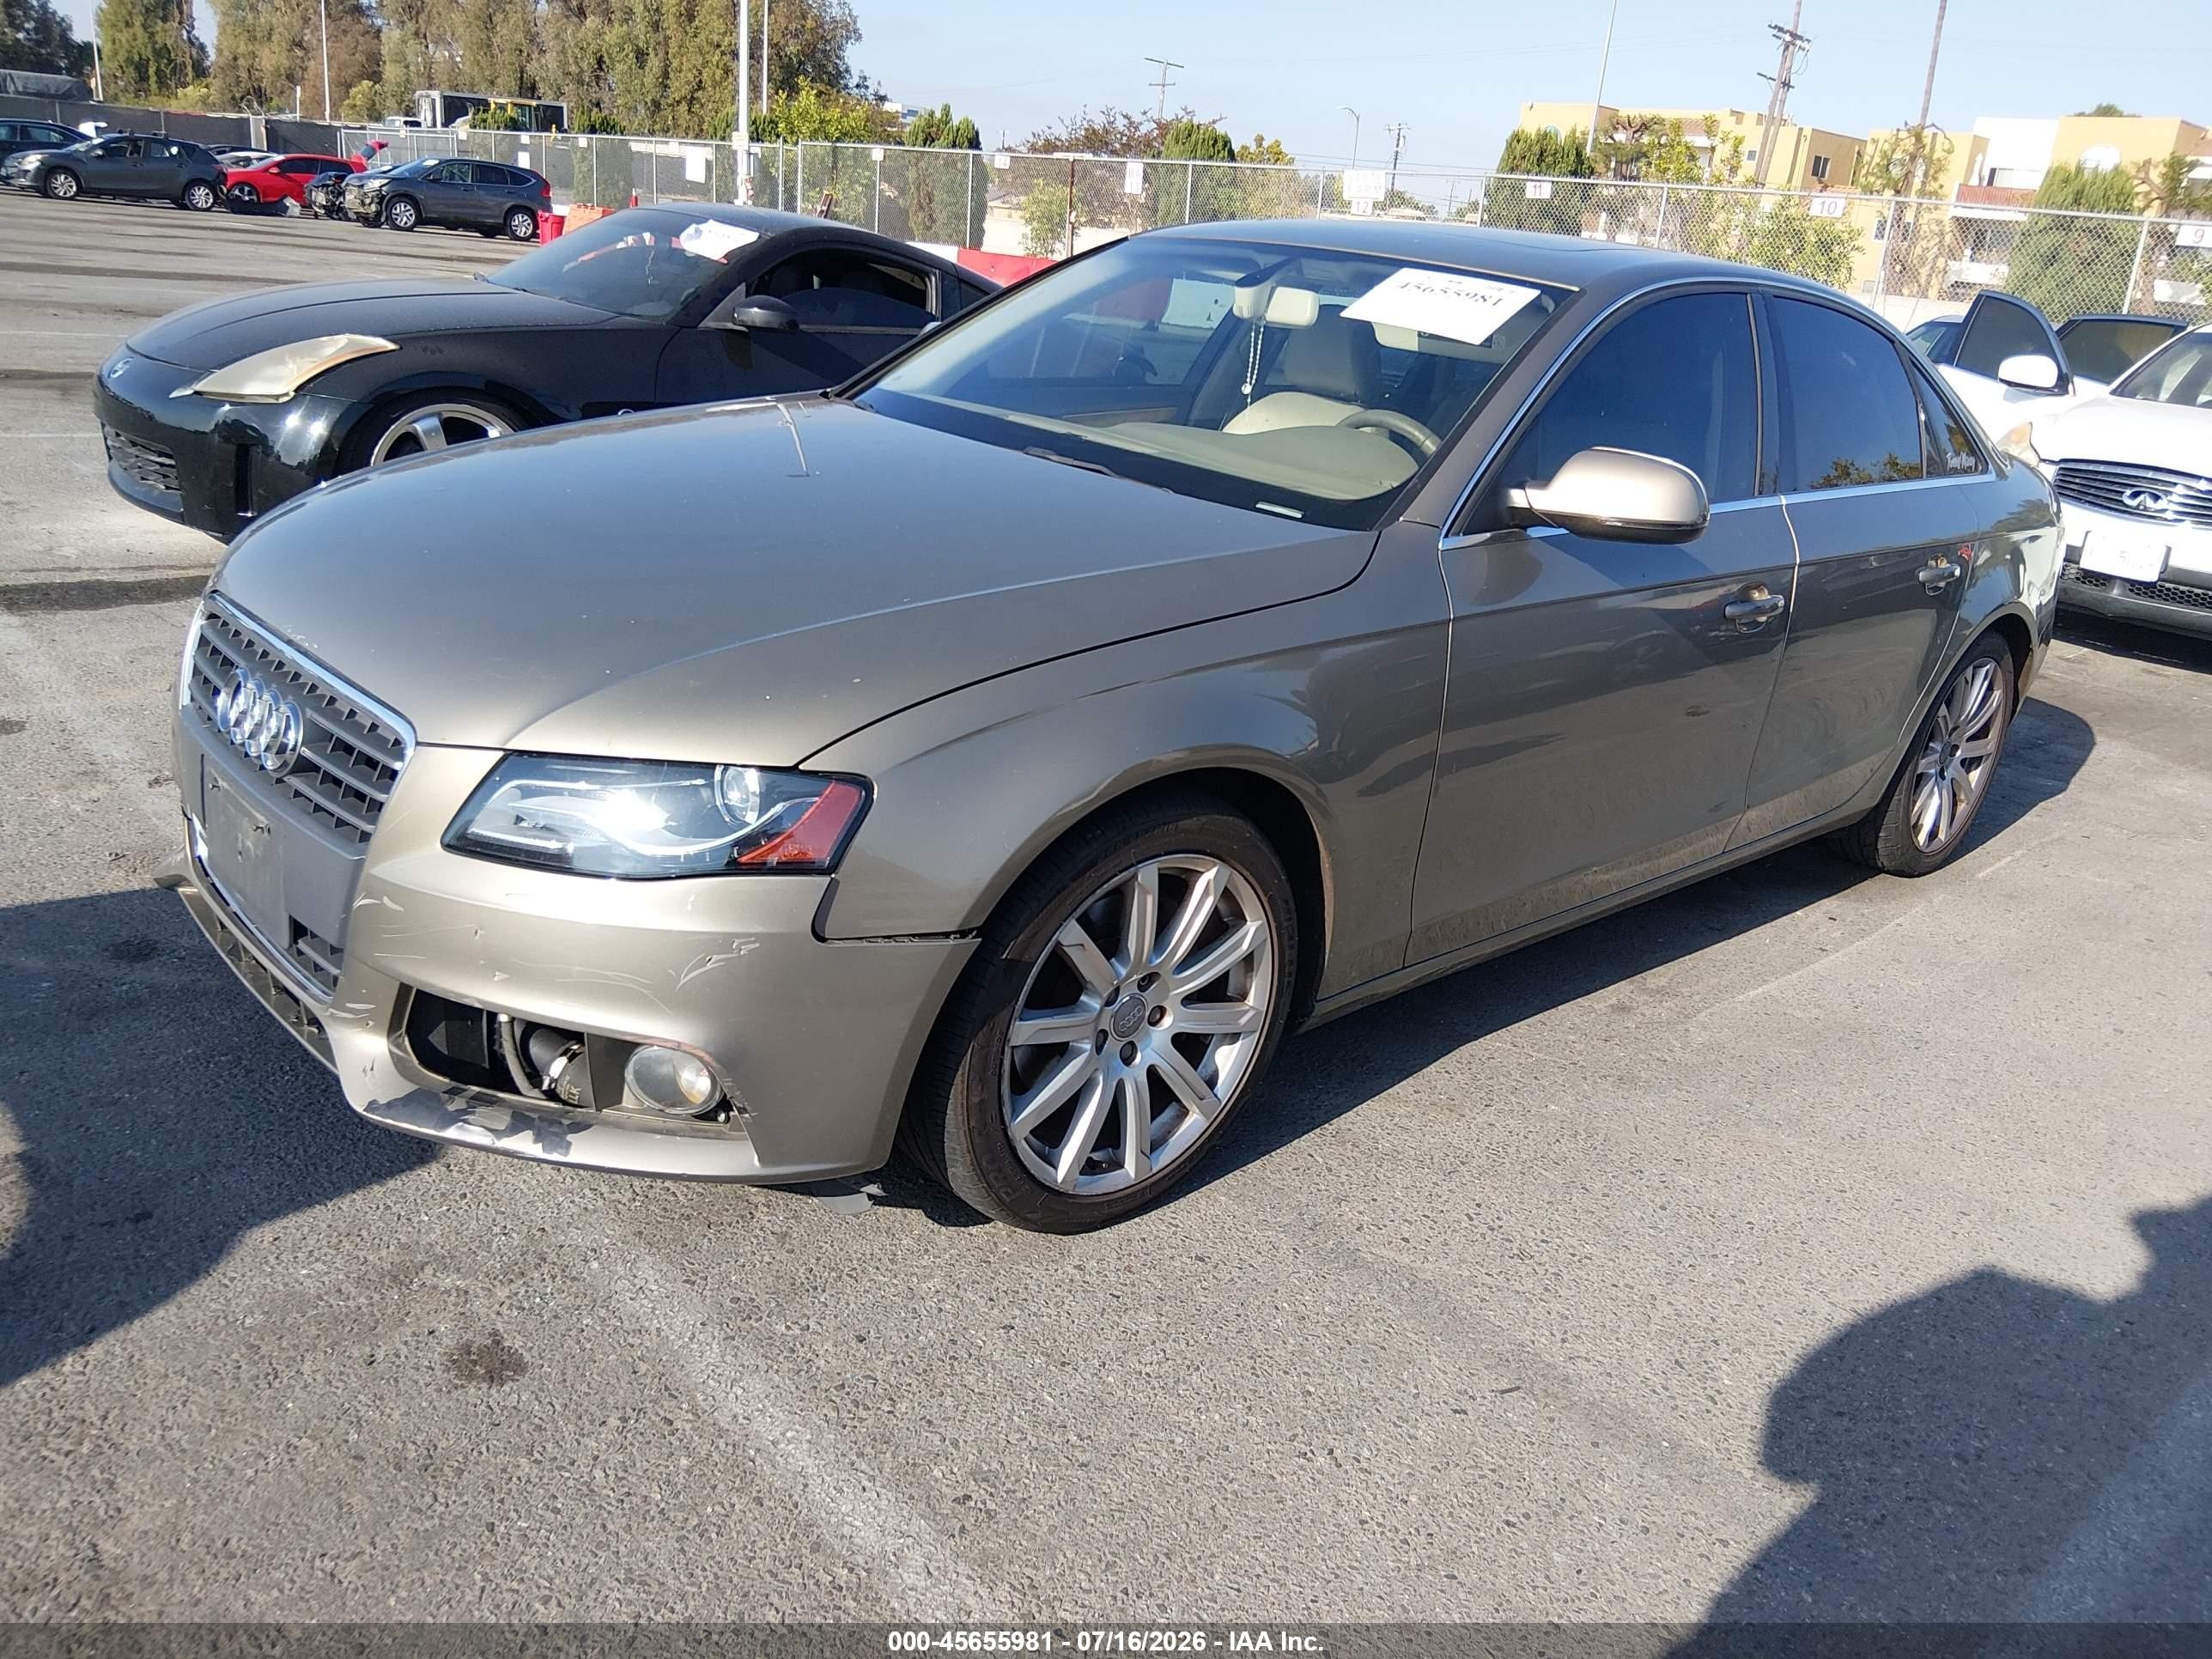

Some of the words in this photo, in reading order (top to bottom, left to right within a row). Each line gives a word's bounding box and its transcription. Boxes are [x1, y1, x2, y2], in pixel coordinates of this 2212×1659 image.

[1532, 183, 1542, 198] 11
[1357, 201, 1369, 214] 12
[1820, 199, 1838, 215] 10
[2191, 228, 2205, 244] 9
